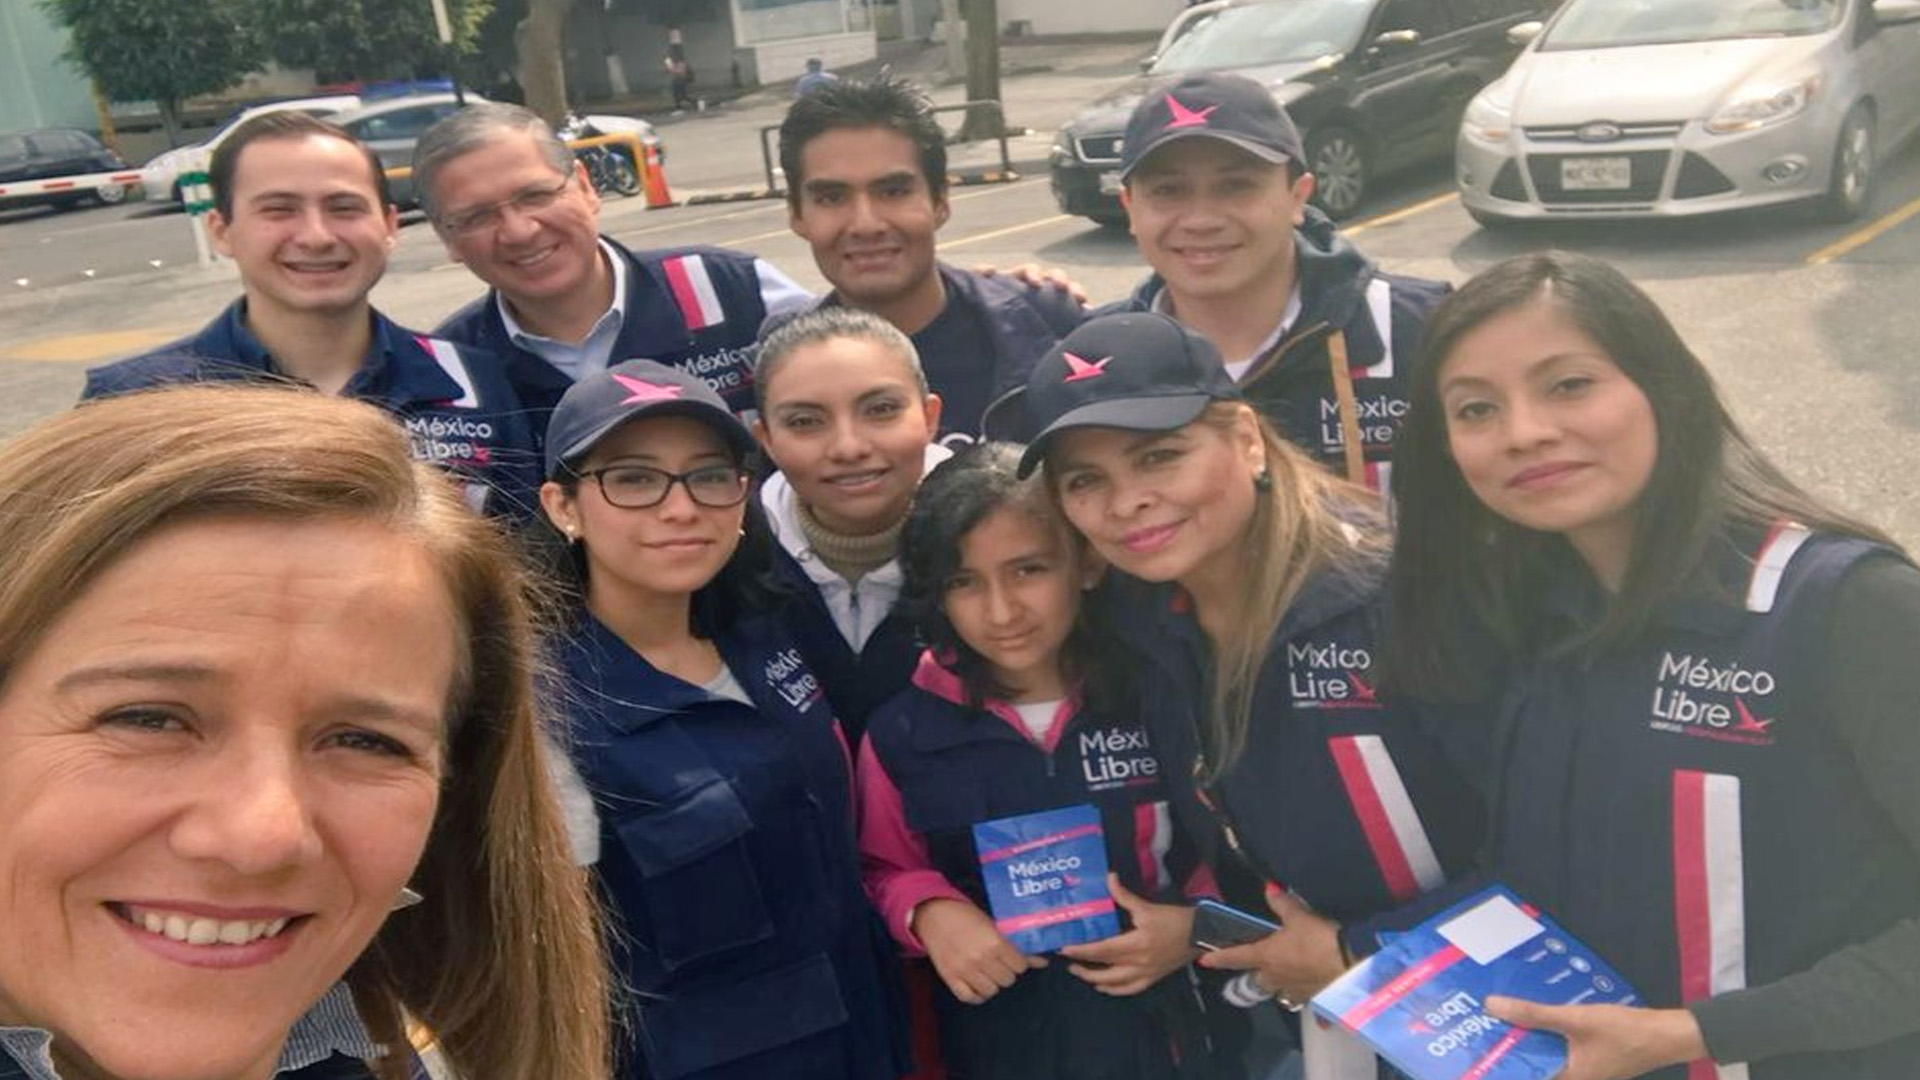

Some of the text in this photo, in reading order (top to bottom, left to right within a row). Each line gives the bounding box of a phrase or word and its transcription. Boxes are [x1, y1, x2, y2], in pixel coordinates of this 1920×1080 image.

[674, 347, 741, 378] Méxic
[704, 371, 741, 393] bre
[405, 416, 493, 438] México
[410, 439, 472, 460] Libre
[1287, 642, 1371, 670] Mxico
[1290, 672, 1349, 700] Lire
[1658, 651, 1775, 695] México
[1652, 686, 1732, 728] Libre
[1080, 727, 1149, 757] Méxi
[1082, 756, 1158, 782] Libre
[1007, 856, 1082, 880] México
[1011, 876, 1063, 898] Libre
[1424, 991, 1480, 1027] Libre
